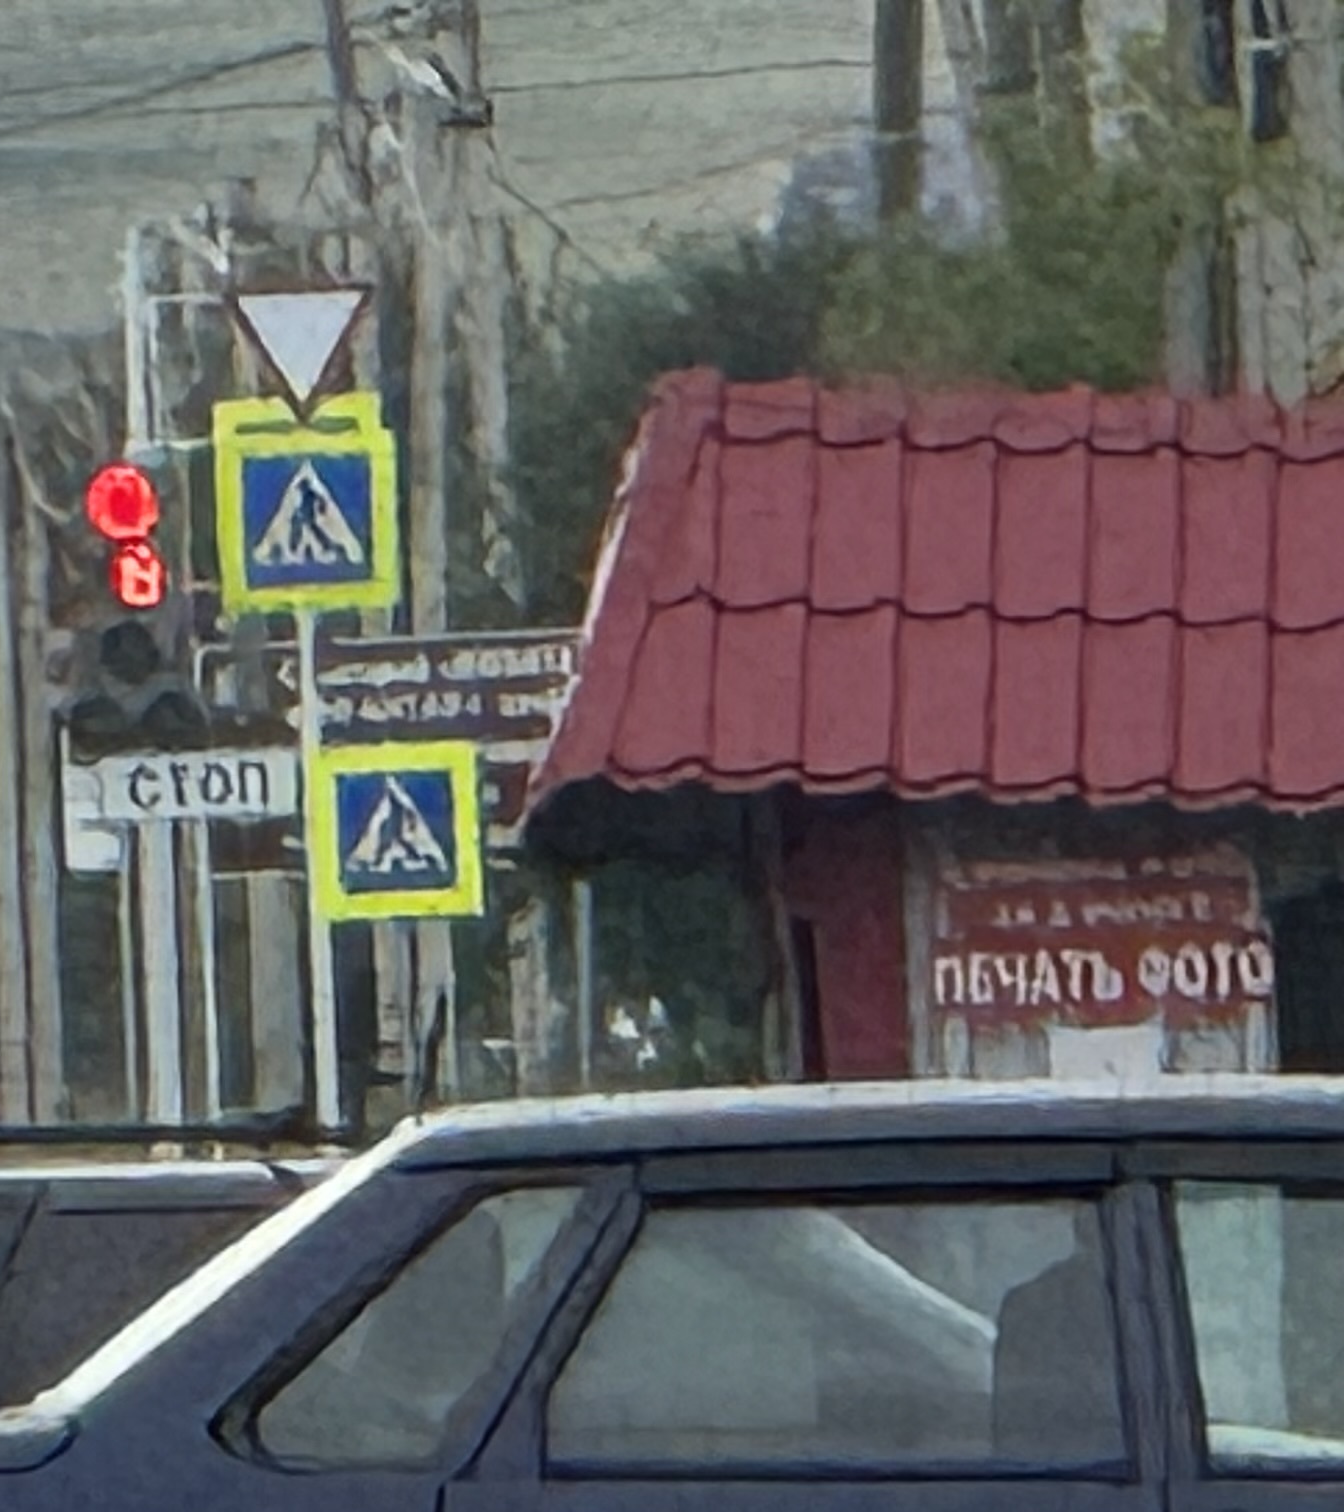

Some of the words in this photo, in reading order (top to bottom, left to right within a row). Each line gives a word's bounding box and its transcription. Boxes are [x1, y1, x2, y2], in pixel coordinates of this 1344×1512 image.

[127, 760, 270, 808] СТОП
[934, 948, 1124, 1005] ПЕЧАТЬ
[1137, 941, 1275, 1001] ФОТО
